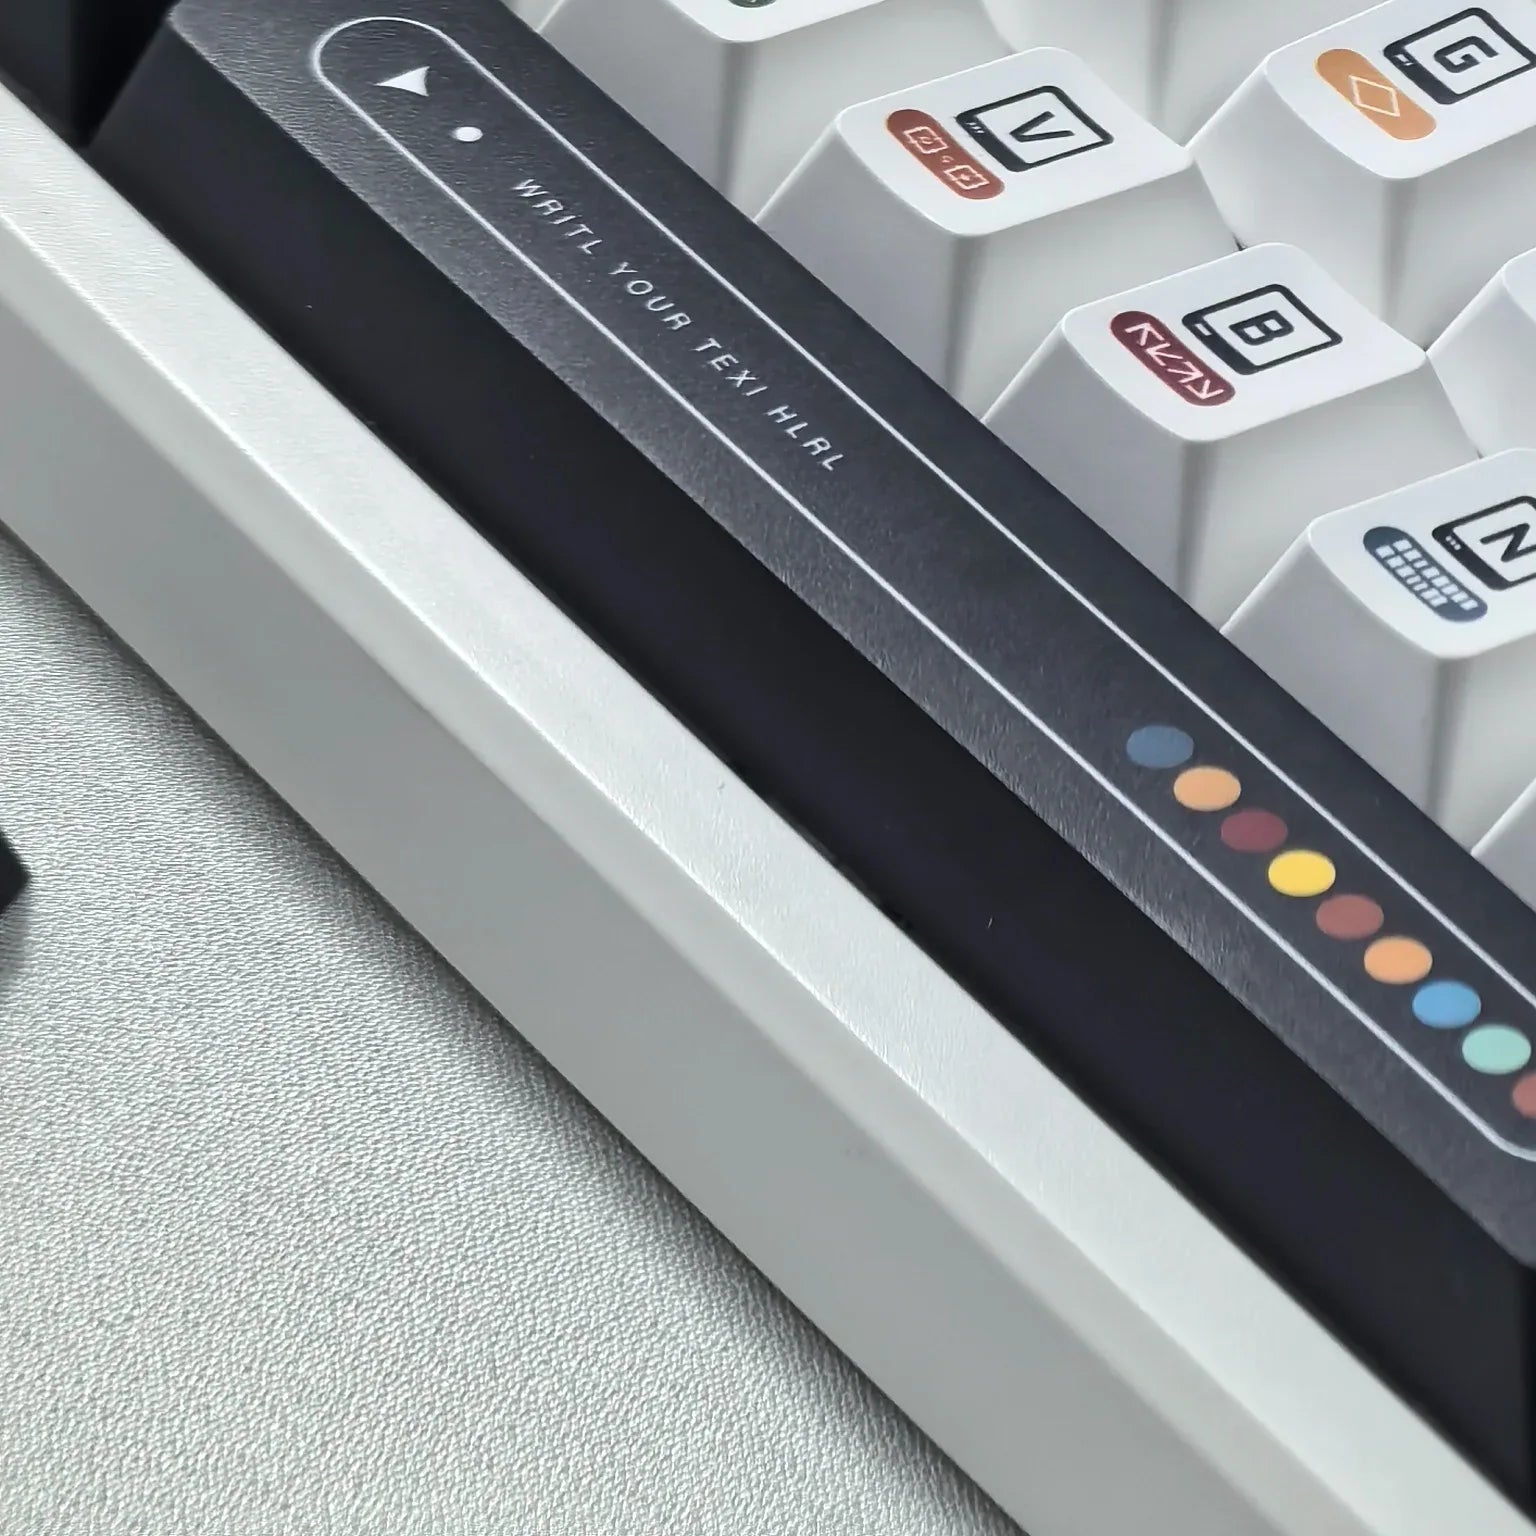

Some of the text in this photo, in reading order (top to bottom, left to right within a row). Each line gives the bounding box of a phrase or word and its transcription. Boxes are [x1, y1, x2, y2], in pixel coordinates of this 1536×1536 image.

[1434, 35, 1495, 70] G
[1009, 111, 1074, 142] V
[609, 262, 691, 329] YOUR
[1229, 310, 1293, 345] B
